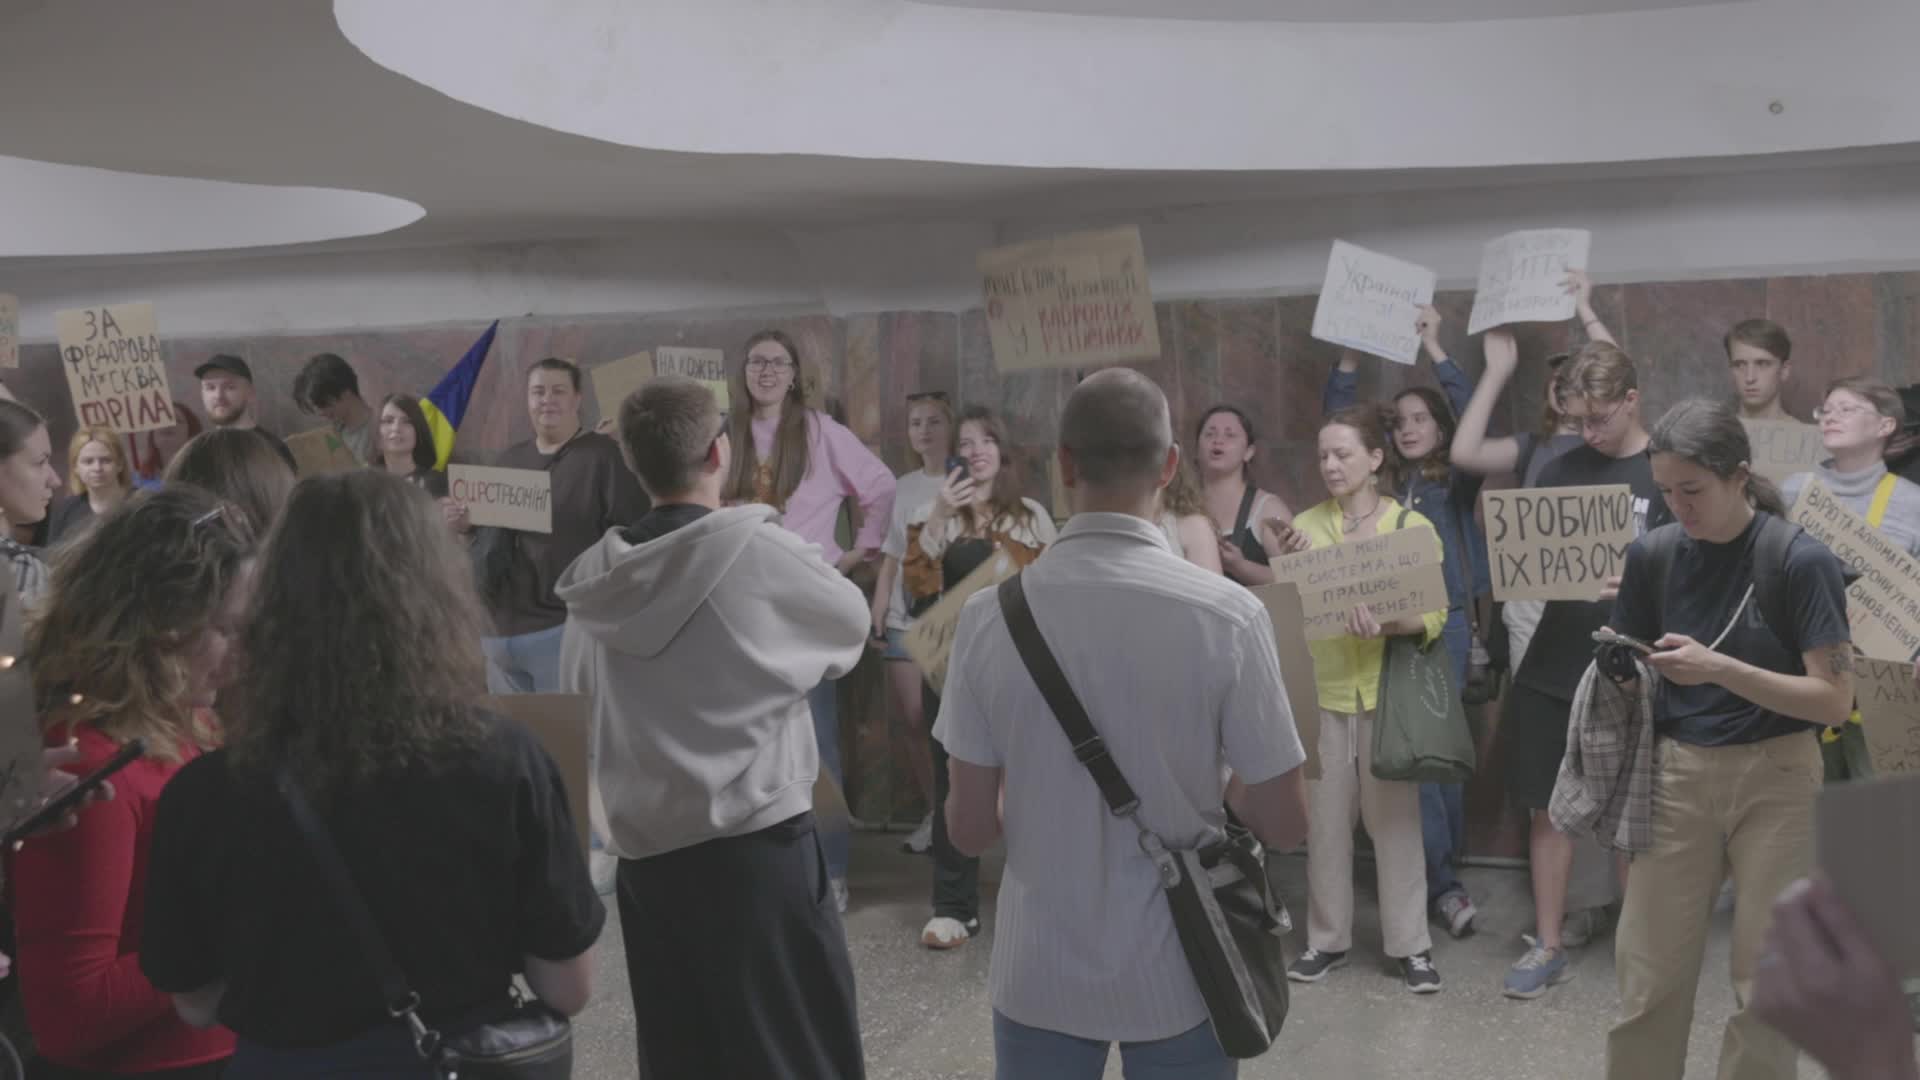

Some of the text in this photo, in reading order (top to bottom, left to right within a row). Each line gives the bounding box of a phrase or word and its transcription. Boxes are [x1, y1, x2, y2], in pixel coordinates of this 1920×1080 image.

[84, 307, 122, 341] ЗА
[1355, 538, 1390, 556] МЕНІ
[1494, 542, 1631, 587] ЇХ РАЗОМ
[1323, 576, 1400, 604] ПРАЦЮЄ
[1304, 611, 1345, 626] РОТИ
